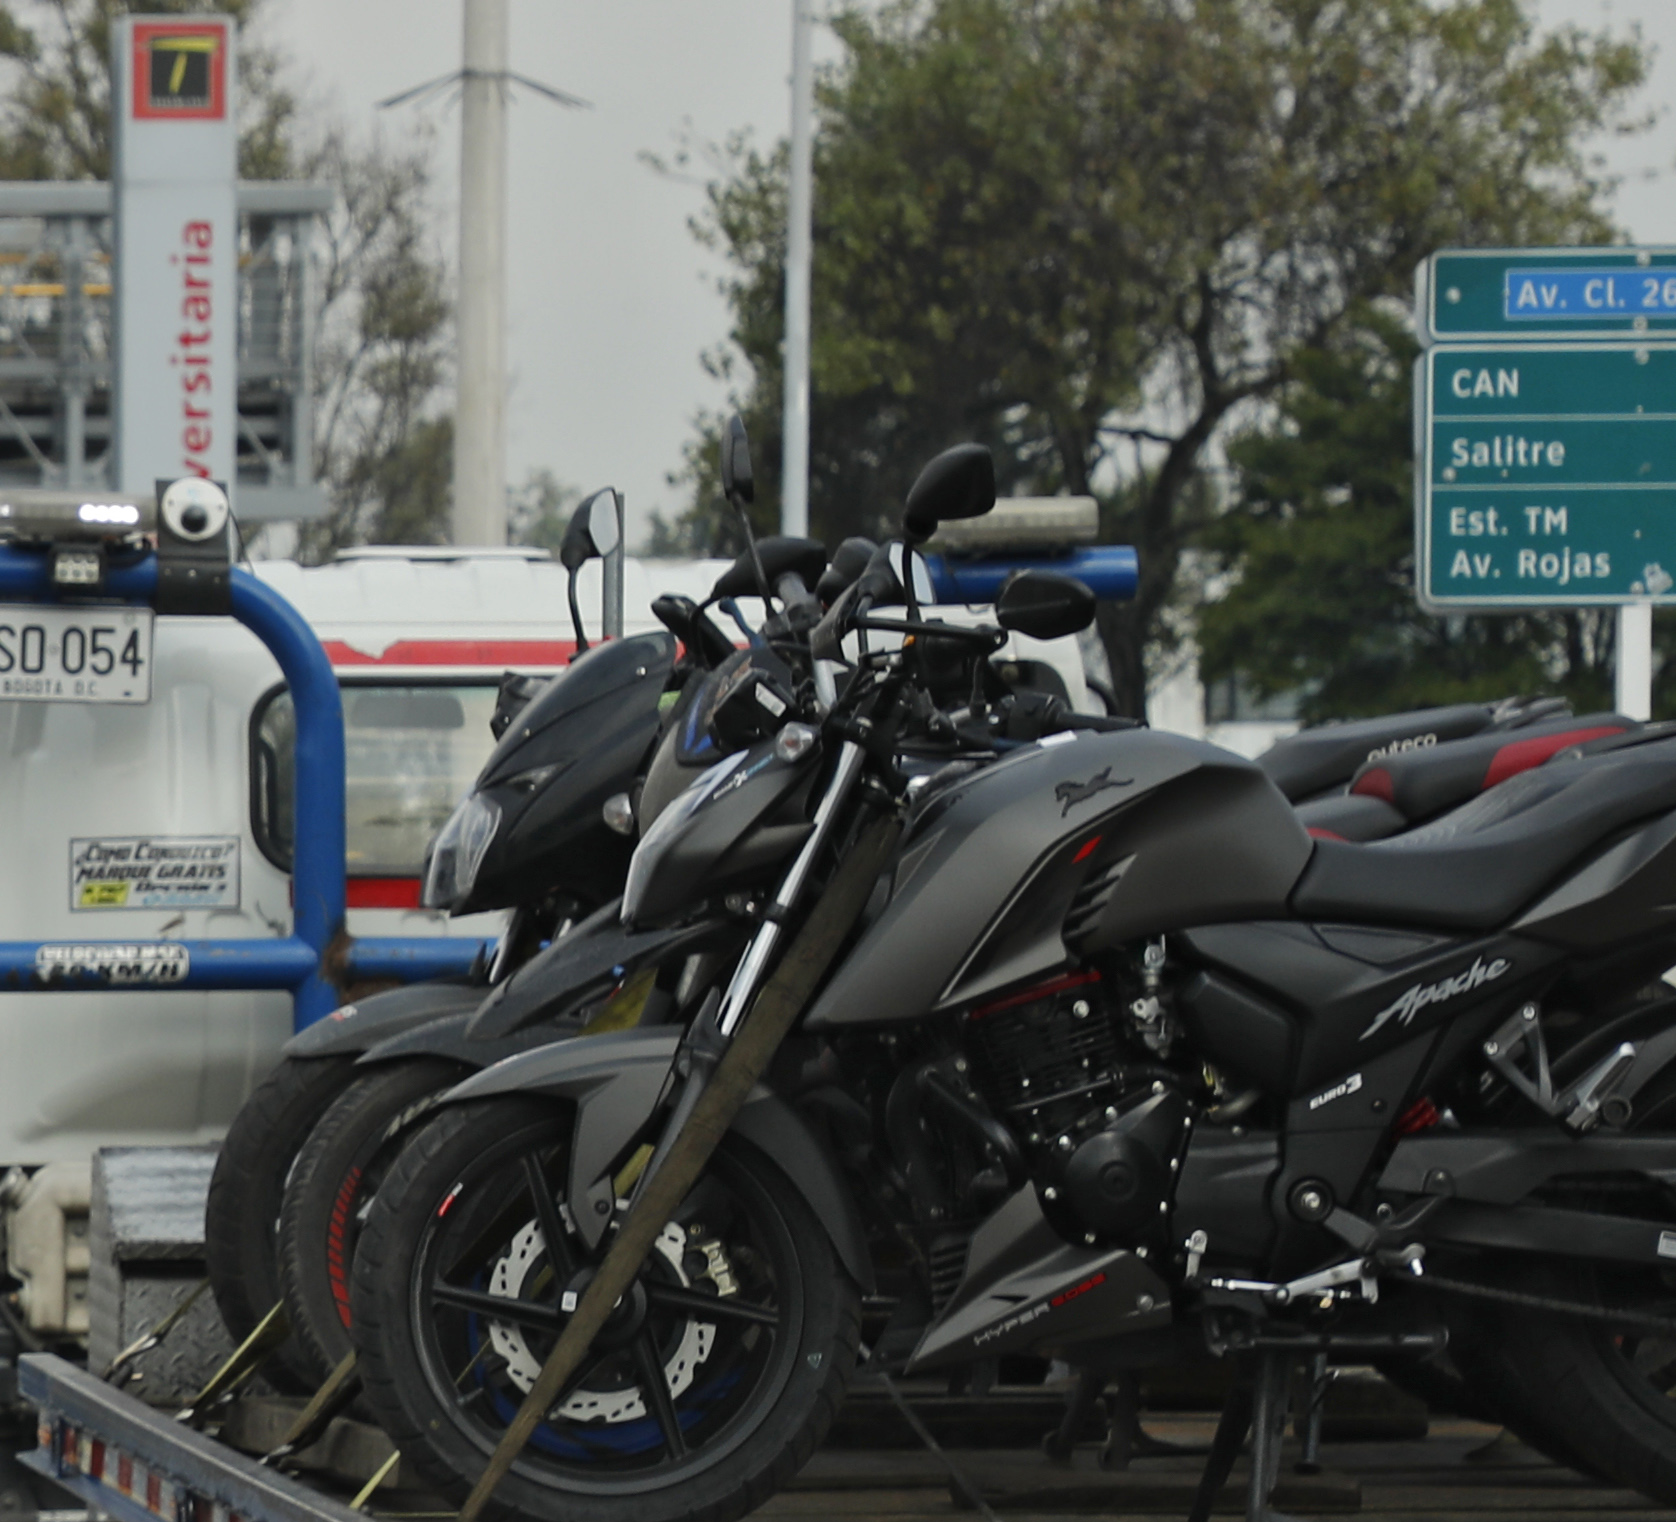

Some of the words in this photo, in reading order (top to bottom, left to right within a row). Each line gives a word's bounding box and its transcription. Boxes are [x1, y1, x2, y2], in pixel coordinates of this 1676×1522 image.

[1516, 279, 1568, 309] Av.
[1641, 278, 1676, 308] 26
[168, 219, 215, 479] versitaria
[1452, 367, 1520, 398] CAN
[1451, 434, 1567, 467] Salitre
[1450, 505, 1508, 536] Est.
[1524, 505, 1568, 535] TM
[1450, 549, 1501, 578] Av.
[1517, 546, 1612, 586] Rojas
[156, 863, 227, 880] GRATIS
[1358, 955, 1512, 1041] Apache
